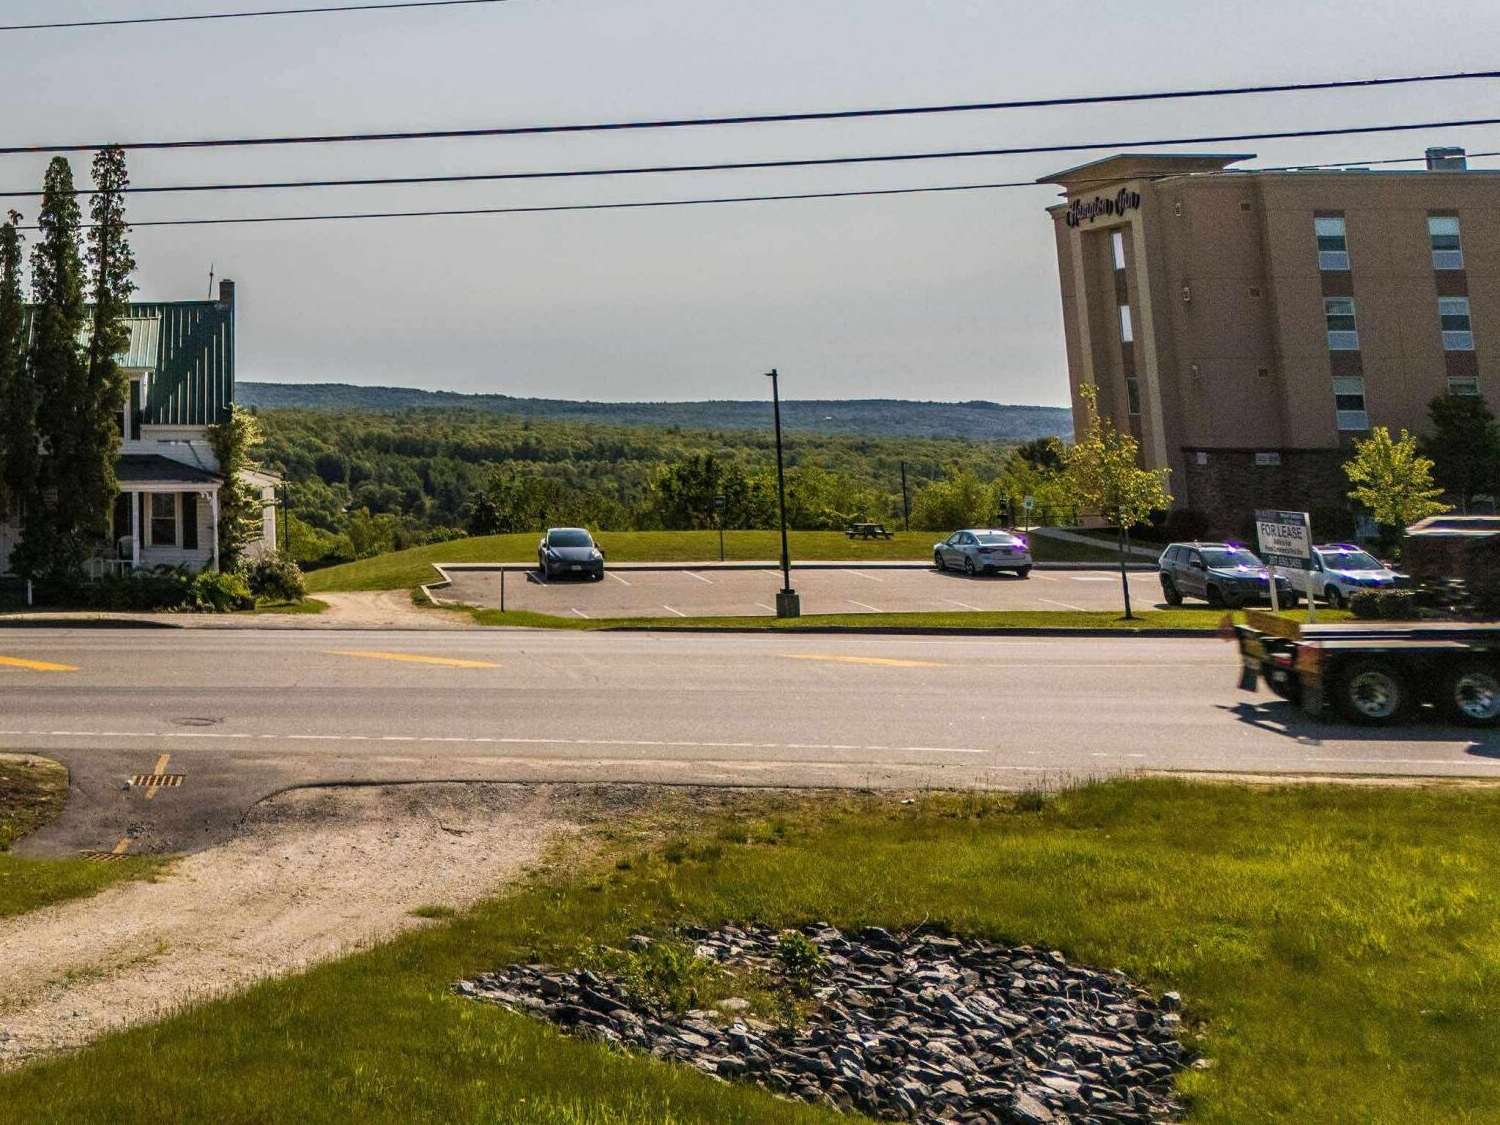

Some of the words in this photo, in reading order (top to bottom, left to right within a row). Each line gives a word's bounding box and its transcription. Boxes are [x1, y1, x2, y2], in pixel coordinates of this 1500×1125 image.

[1066, 197, 1113, 228] Hampton
[1115, 188, 1140, 216] Inn
[1261, 524, 1276, 537] FOR
[1277, 526, 1302, 540] LEASE
